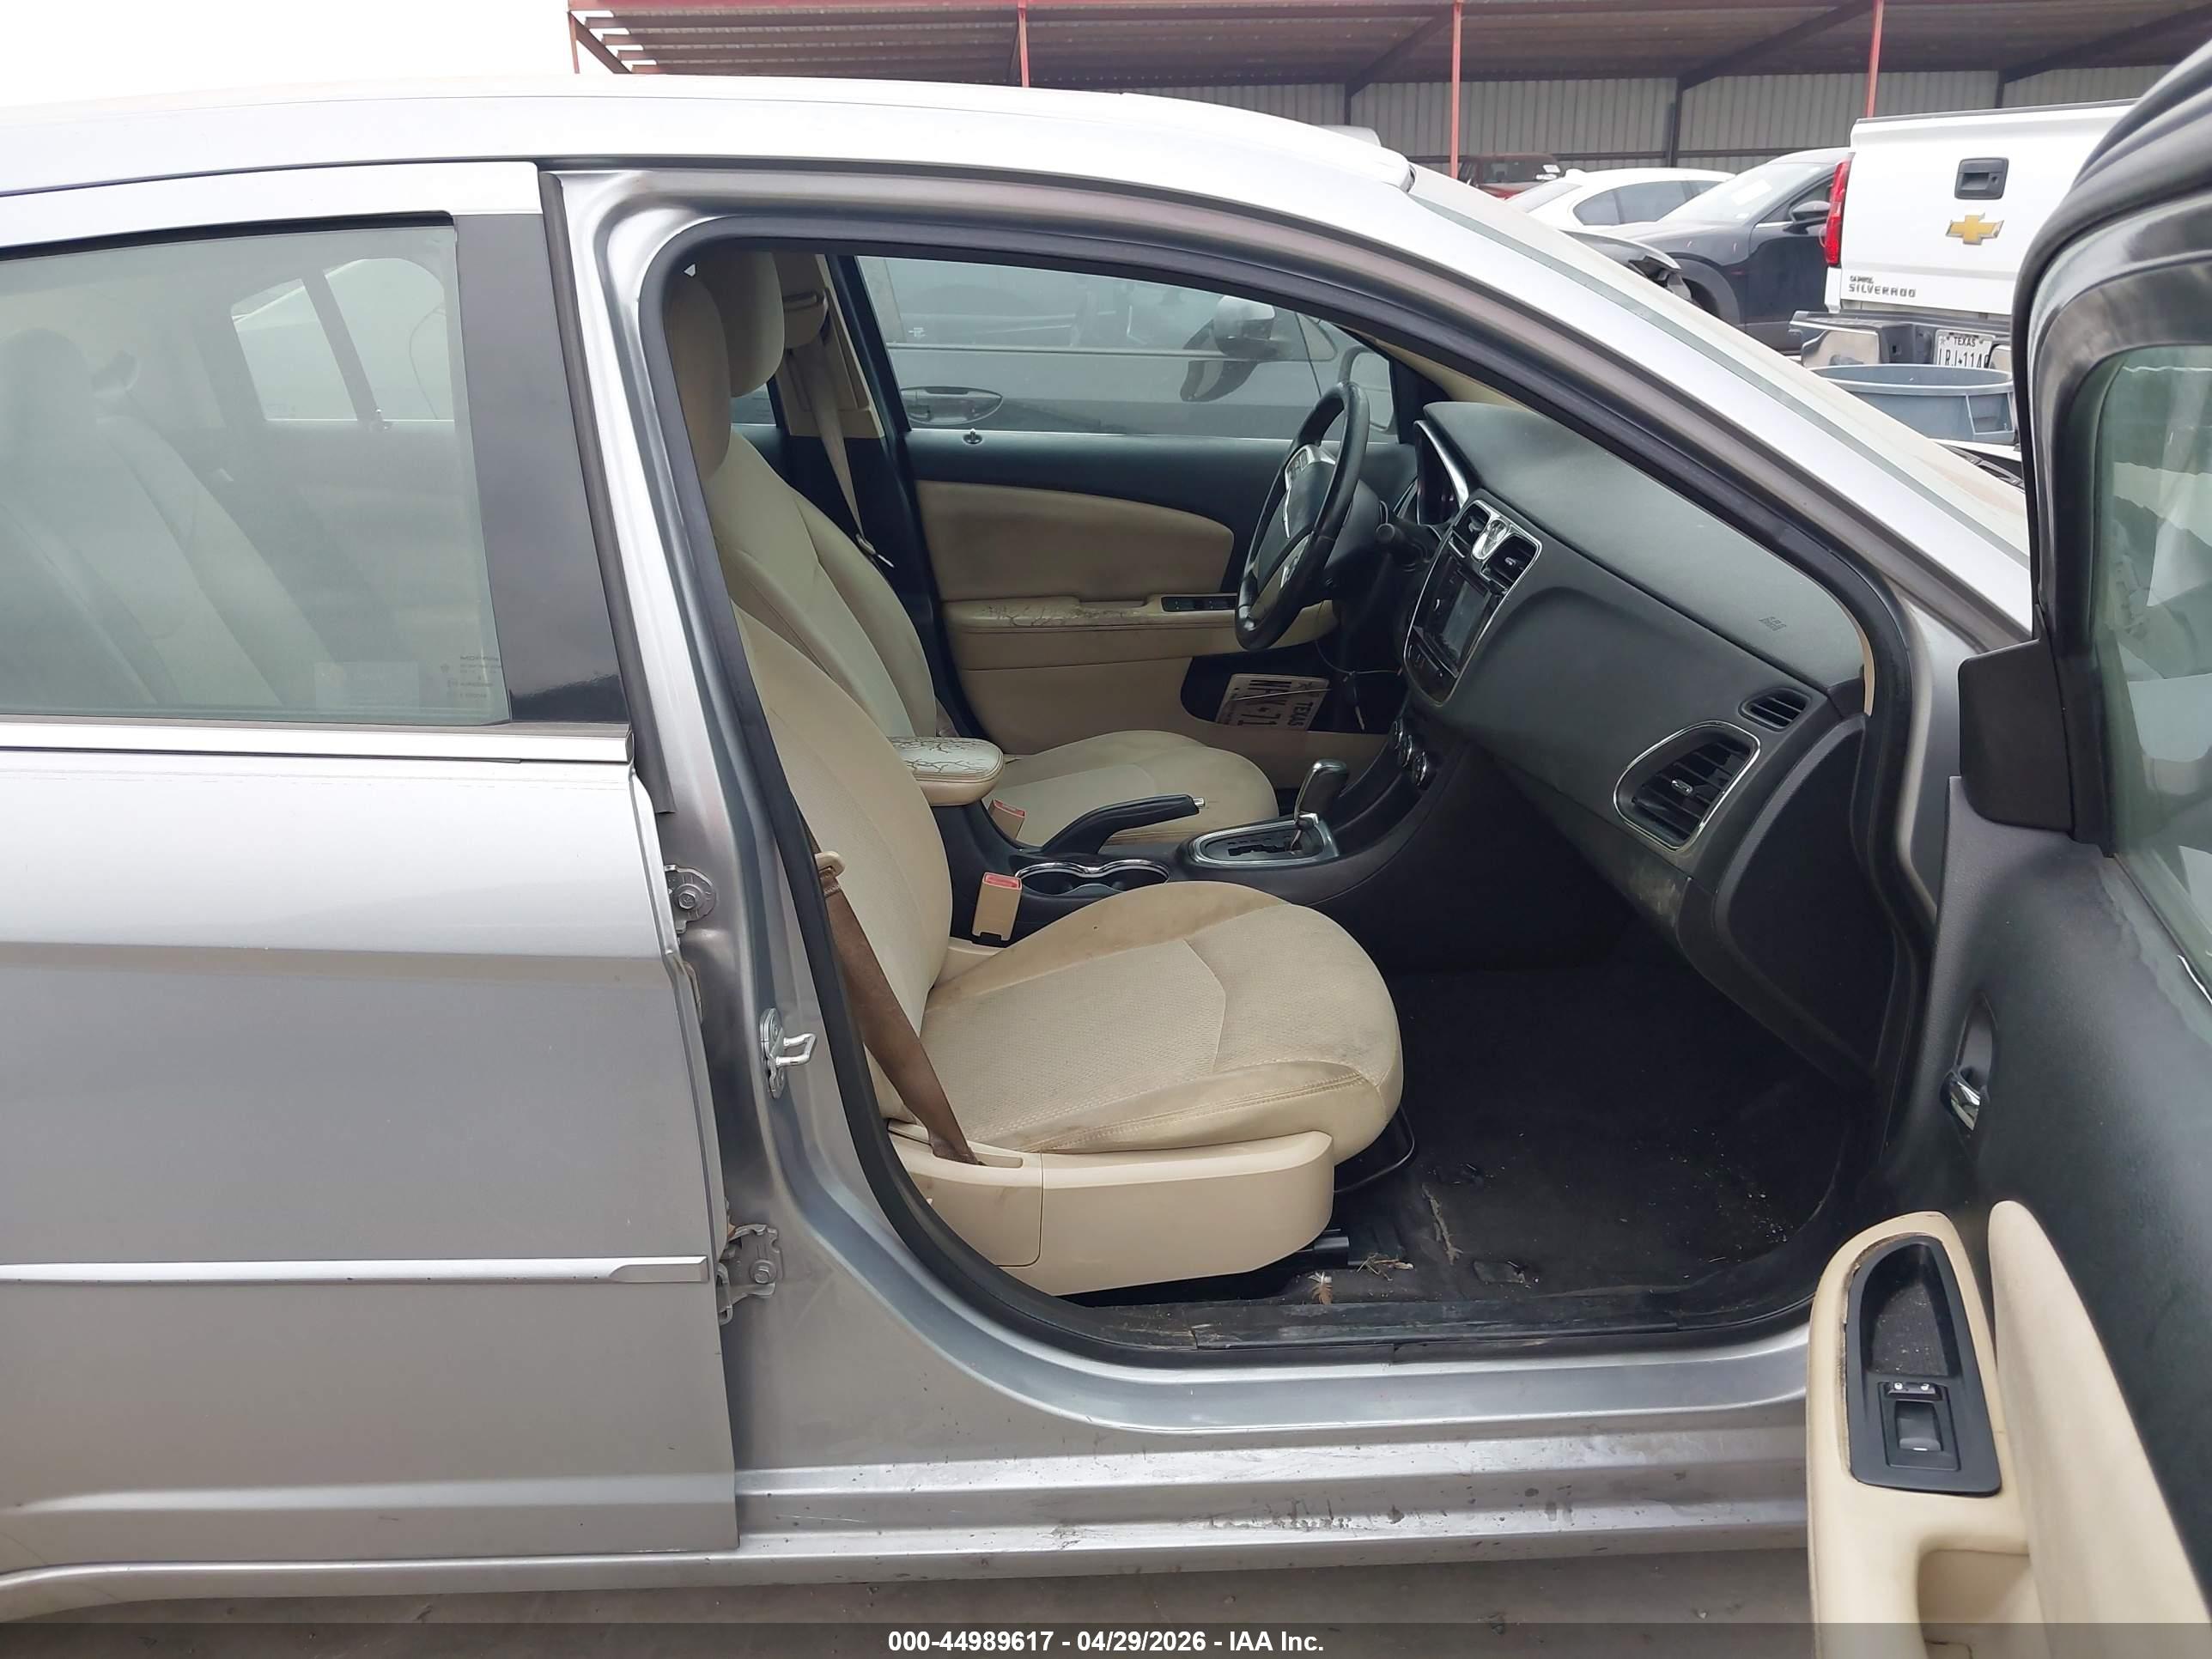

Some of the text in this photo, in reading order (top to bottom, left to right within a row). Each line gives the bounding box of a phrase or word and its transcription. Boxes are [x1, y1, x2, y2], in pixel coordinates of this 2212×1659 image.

[1849, 283, 1917, 298] SILVERADO
[1954, 336, 1976, 348] TEXAS
[1287, 702, 1314, 726] TEXAS
